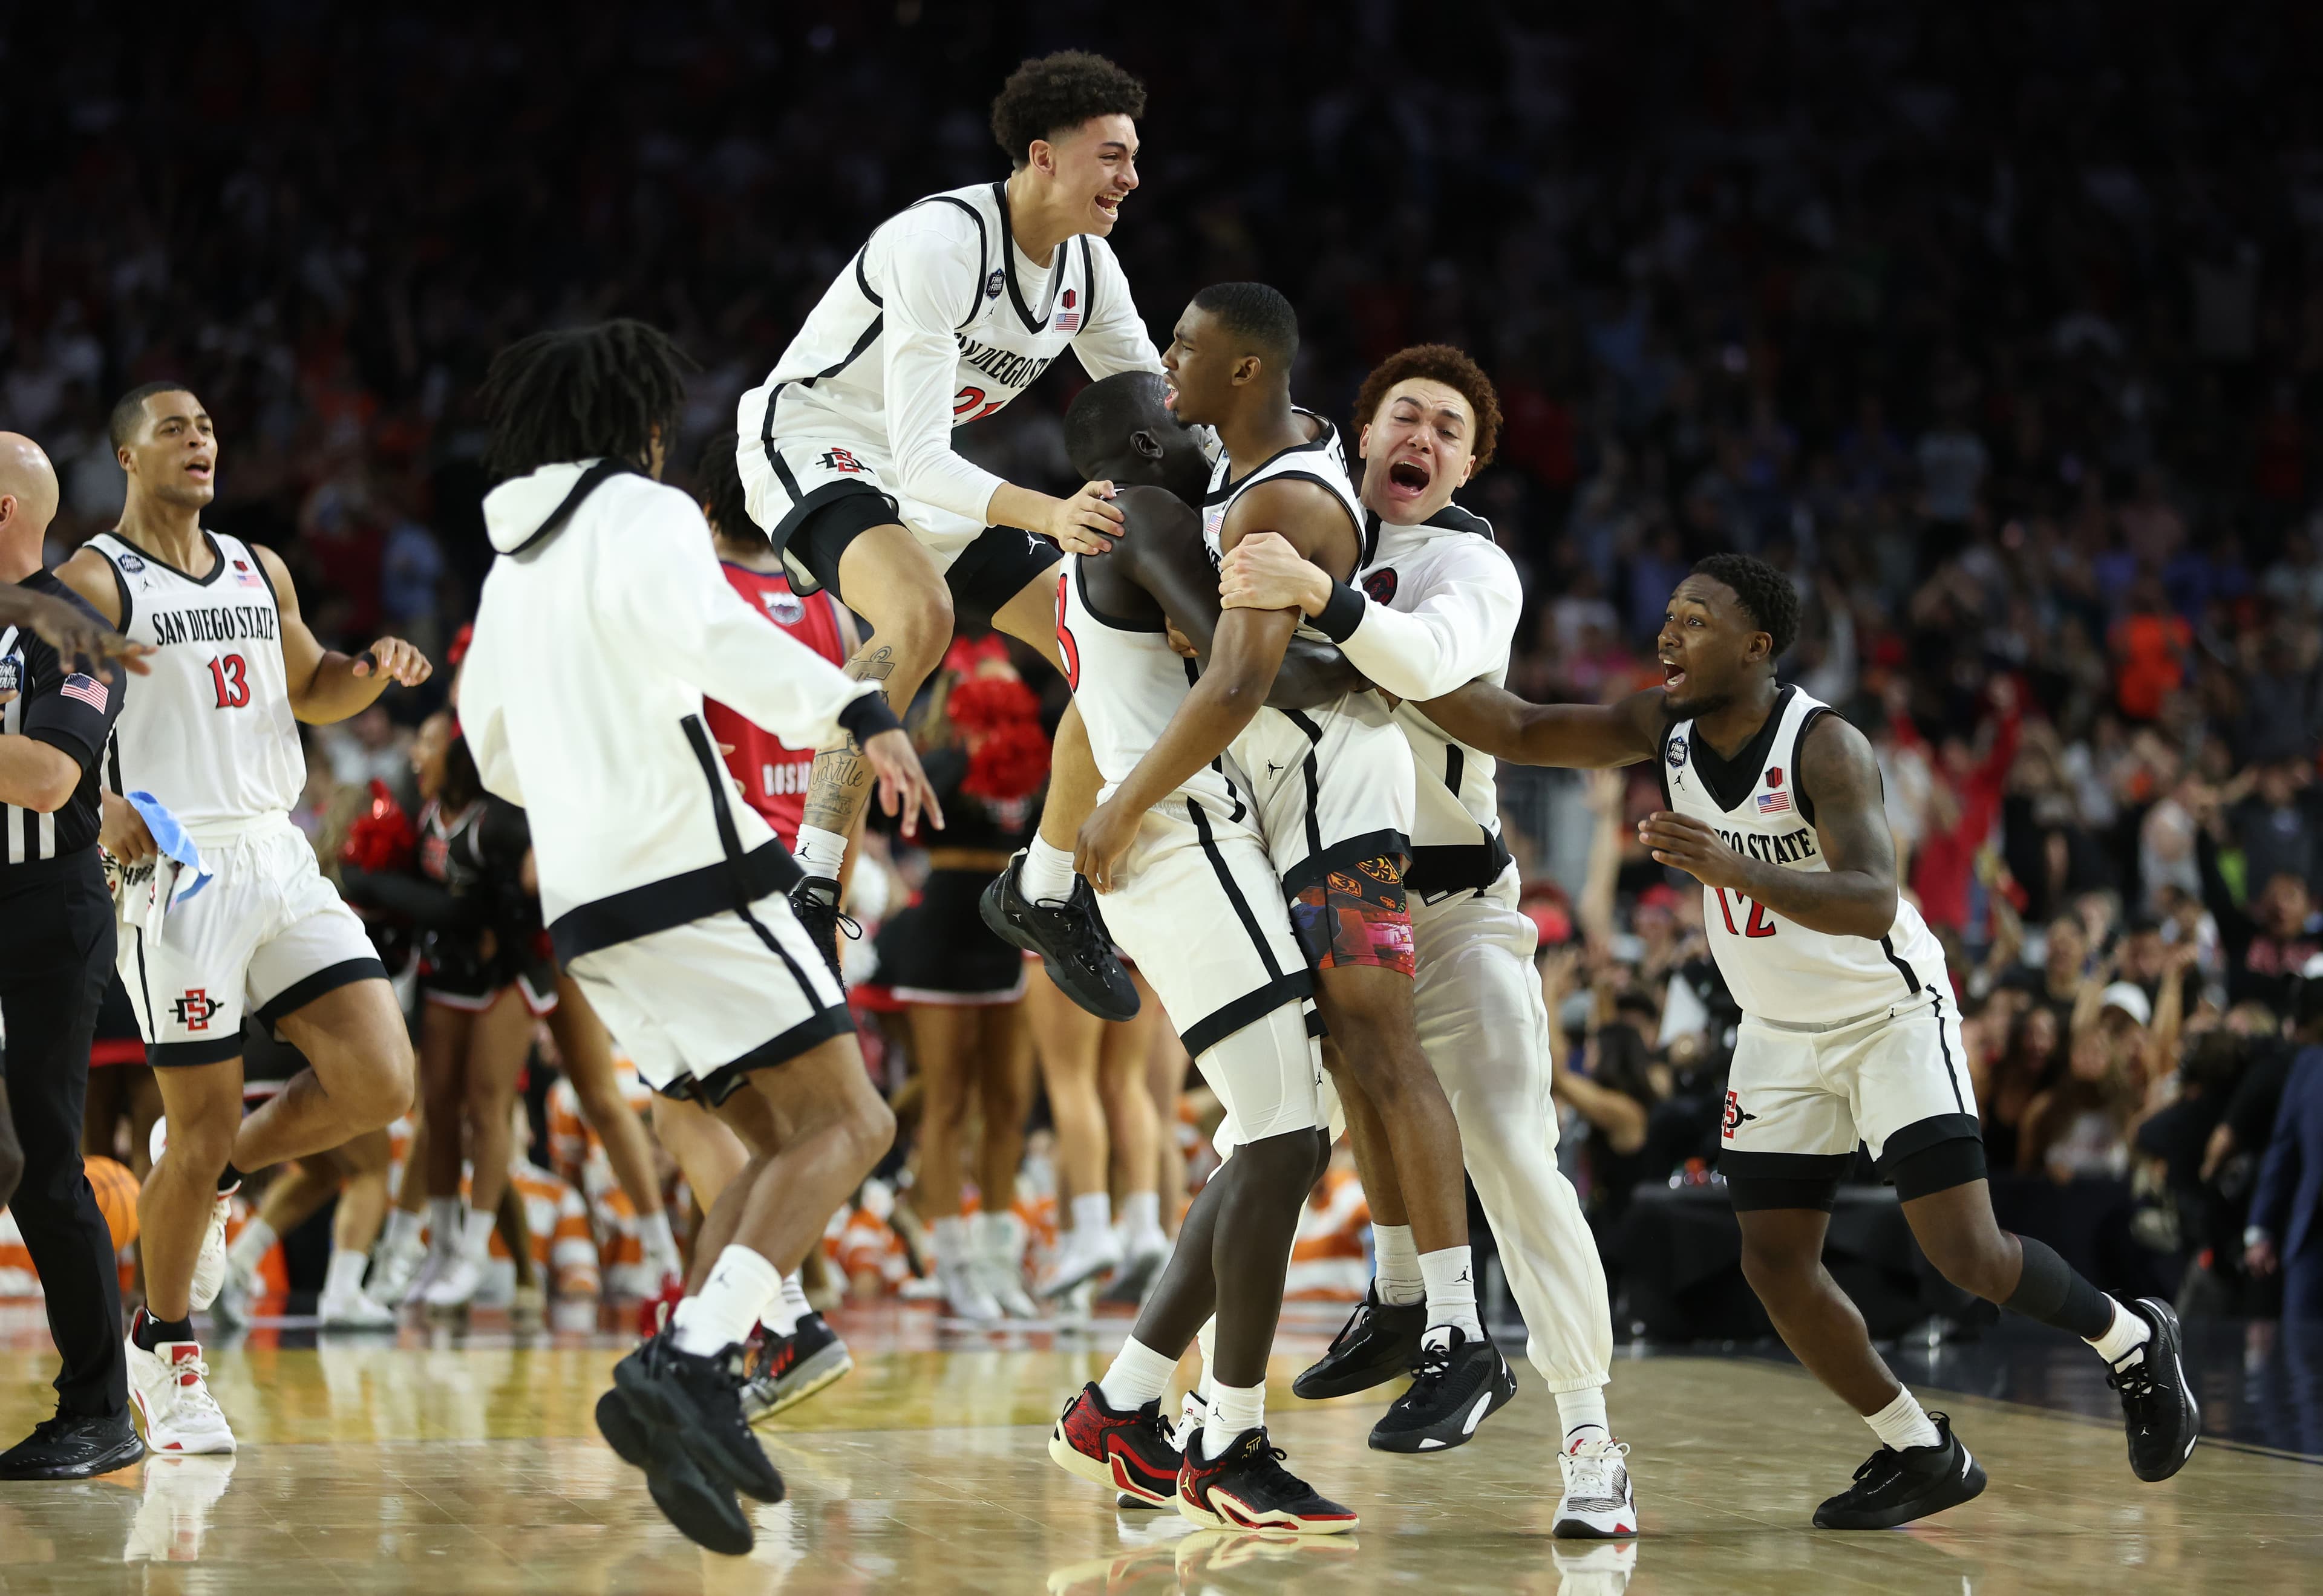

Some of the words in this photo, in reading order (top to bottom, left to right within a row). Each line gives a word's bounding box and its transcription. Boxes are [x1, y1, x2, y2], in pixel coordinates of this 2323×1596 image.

[991, 275, 1003, 284] FINAL
[967, 347, 1034, 389] DIEGO
[151, 611, 188, 646] SAN
[185, 607, 235, 641] DIEGO
[235, 606, 274, 640] STATE
[207, 654, 250, 709] 13
[1670, 743, 1685, 754] FINAL
[1670, 751, 1685, 762] FOUR
[1748, 828, 1816, 865] STATE
[1714, 887, 1777, 938] 12
